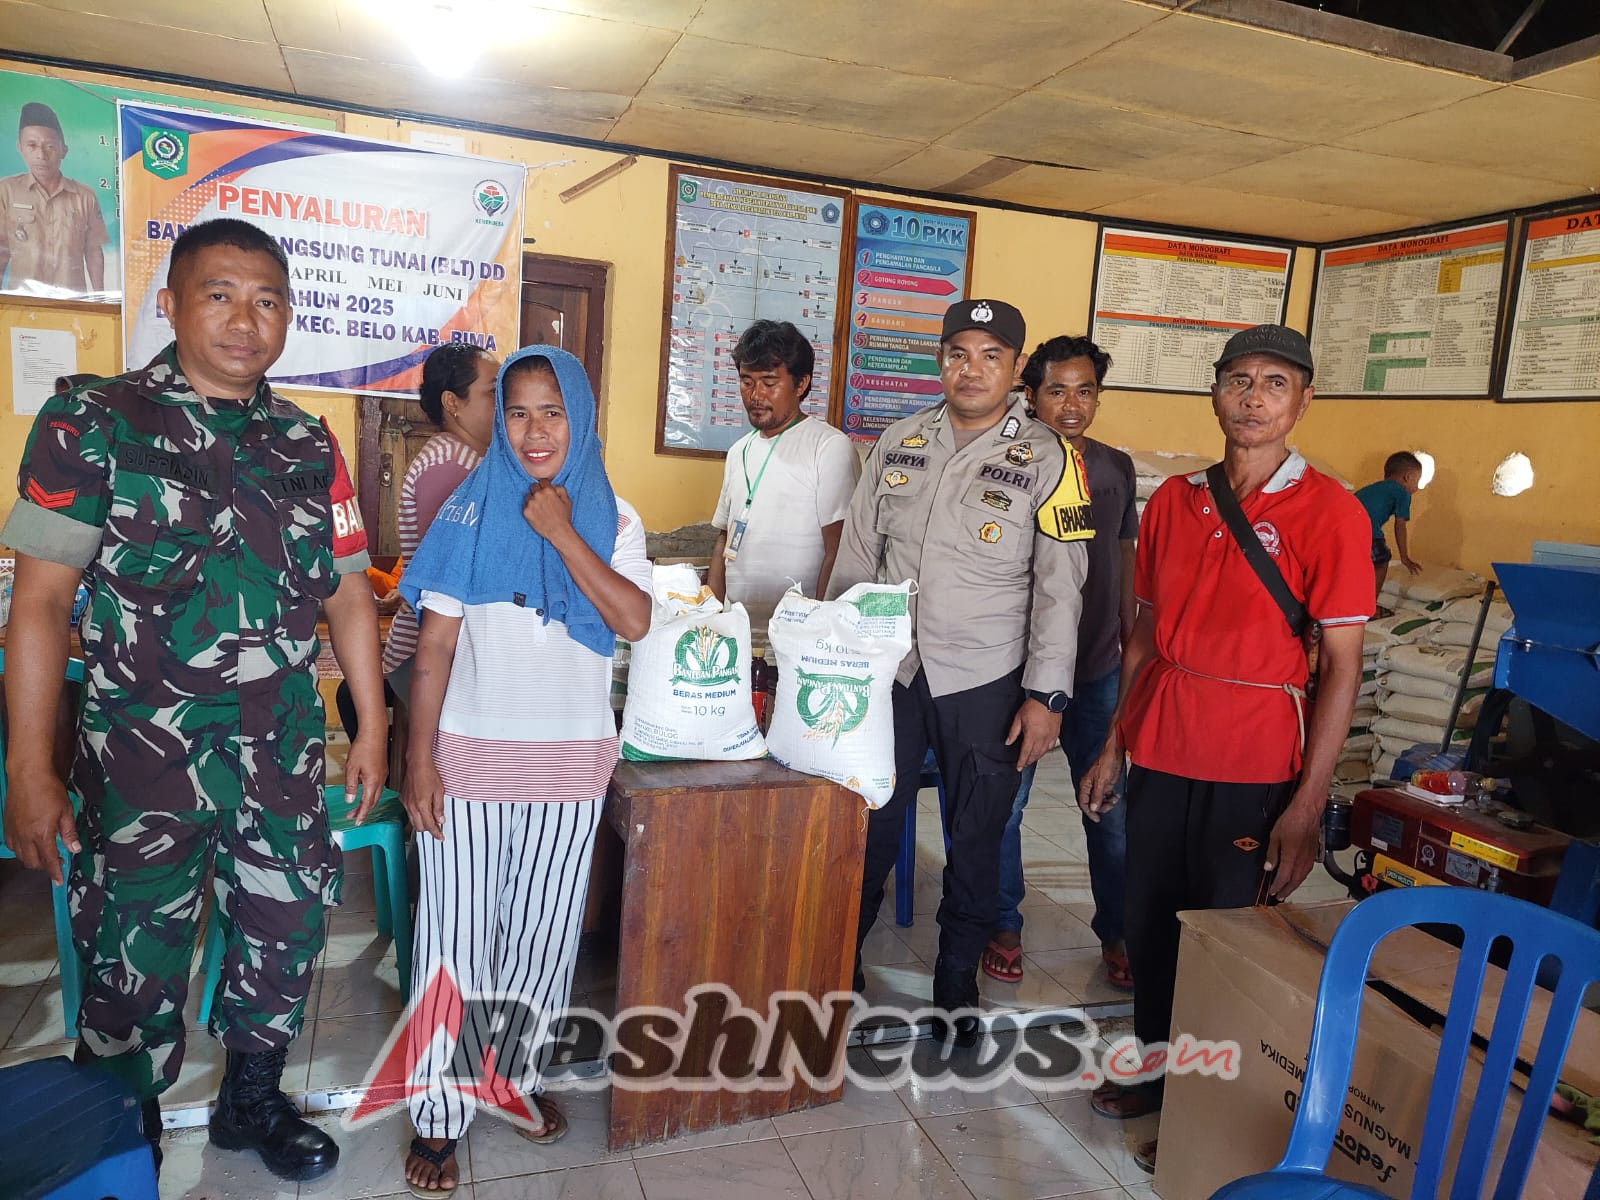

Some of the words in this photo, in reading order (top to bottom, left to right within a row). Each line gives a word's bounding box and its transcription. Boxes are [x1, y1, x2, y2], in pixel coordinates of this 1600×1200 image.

[99, 136, 110, 146] 1.
[100, 179, 111, 189] 2.
[217, 184, 427, 237] PENYALURAN
[1567, 214, 1600, 230] DAT
[893, 215, 920, 239] 10
[923, 225, 964, 246] PKK
[1167, 241, 1188, 251] DATA
[1188, 244, 1231, 255] MONOGRAFI
[1377, 242, 1398, 252] DATA
[1400, 235, 1449, 249] MONOGRAFI
[271, 236, 364, 264] NGSUNG
[370, 248, 426, 272] TUNAI
[431, 255, 475, 281] (BLT)
[479, 262, 506, 281] DD
[862, 251, 870, 264] 1
[875, 252, 912, 263] PENGHAYATAN
[290, 266, 347, 285] APRIL
[367, 276, 403, 293] MEI
[423, 283, 463, 301] JUNI
[860, 271, 870, 284] 2
[874, 276, 897, 284] GOTONG
[897, 279, 919, 287] ROYONG
[288, 288, 340, 310] AHUN
[346, 295, 394, 316] 2025
[858, 293, 869, 305] 3
[857, 313, 868, 326] 4
[296, 314, 341, 335] KEC.
[347, 319, 396, 341] BELO
[402, 325, 446, 345] KAB.
[451, 331, 497, 351] BIMA
[853, 332, 866, 347] 5
[869, 341, 889, 349] RUMAH
[853, 354, 864, 367] 6
[868, 355, 901, 364] PENDIDIKAN
[852, 375, 862, 389] 7
[865, 379, 908, 388] KESEHATAN
[850, 394, 861, 407] 8
[848, 415, 859, 427] 9
[885, 452, 926, 468] SURYA
[980, 465, 1031, 490] POLRI
[275, 478, 307, 493] TNI
[815, 638, 832, 653] kg
[836, 645, 849, 655] 10
[801, 655, 838, 667] MEDIUM
[840, 660, 870, 669] BERAS
[673, 689, 702, 699] BERAS
[705, 689, 737, 699] MEDIUM
[693, 705, 707, 716] 10
[710, 705, 726, 717] kg
[1259, 1039, 1305, 1084] MEDIKA
[1348, 1085, 1386, 1113] ANTROP
[1345, 1103, 1412, 1158] MAGNUS
[1335, 1130, 1397, 1184] fedor
